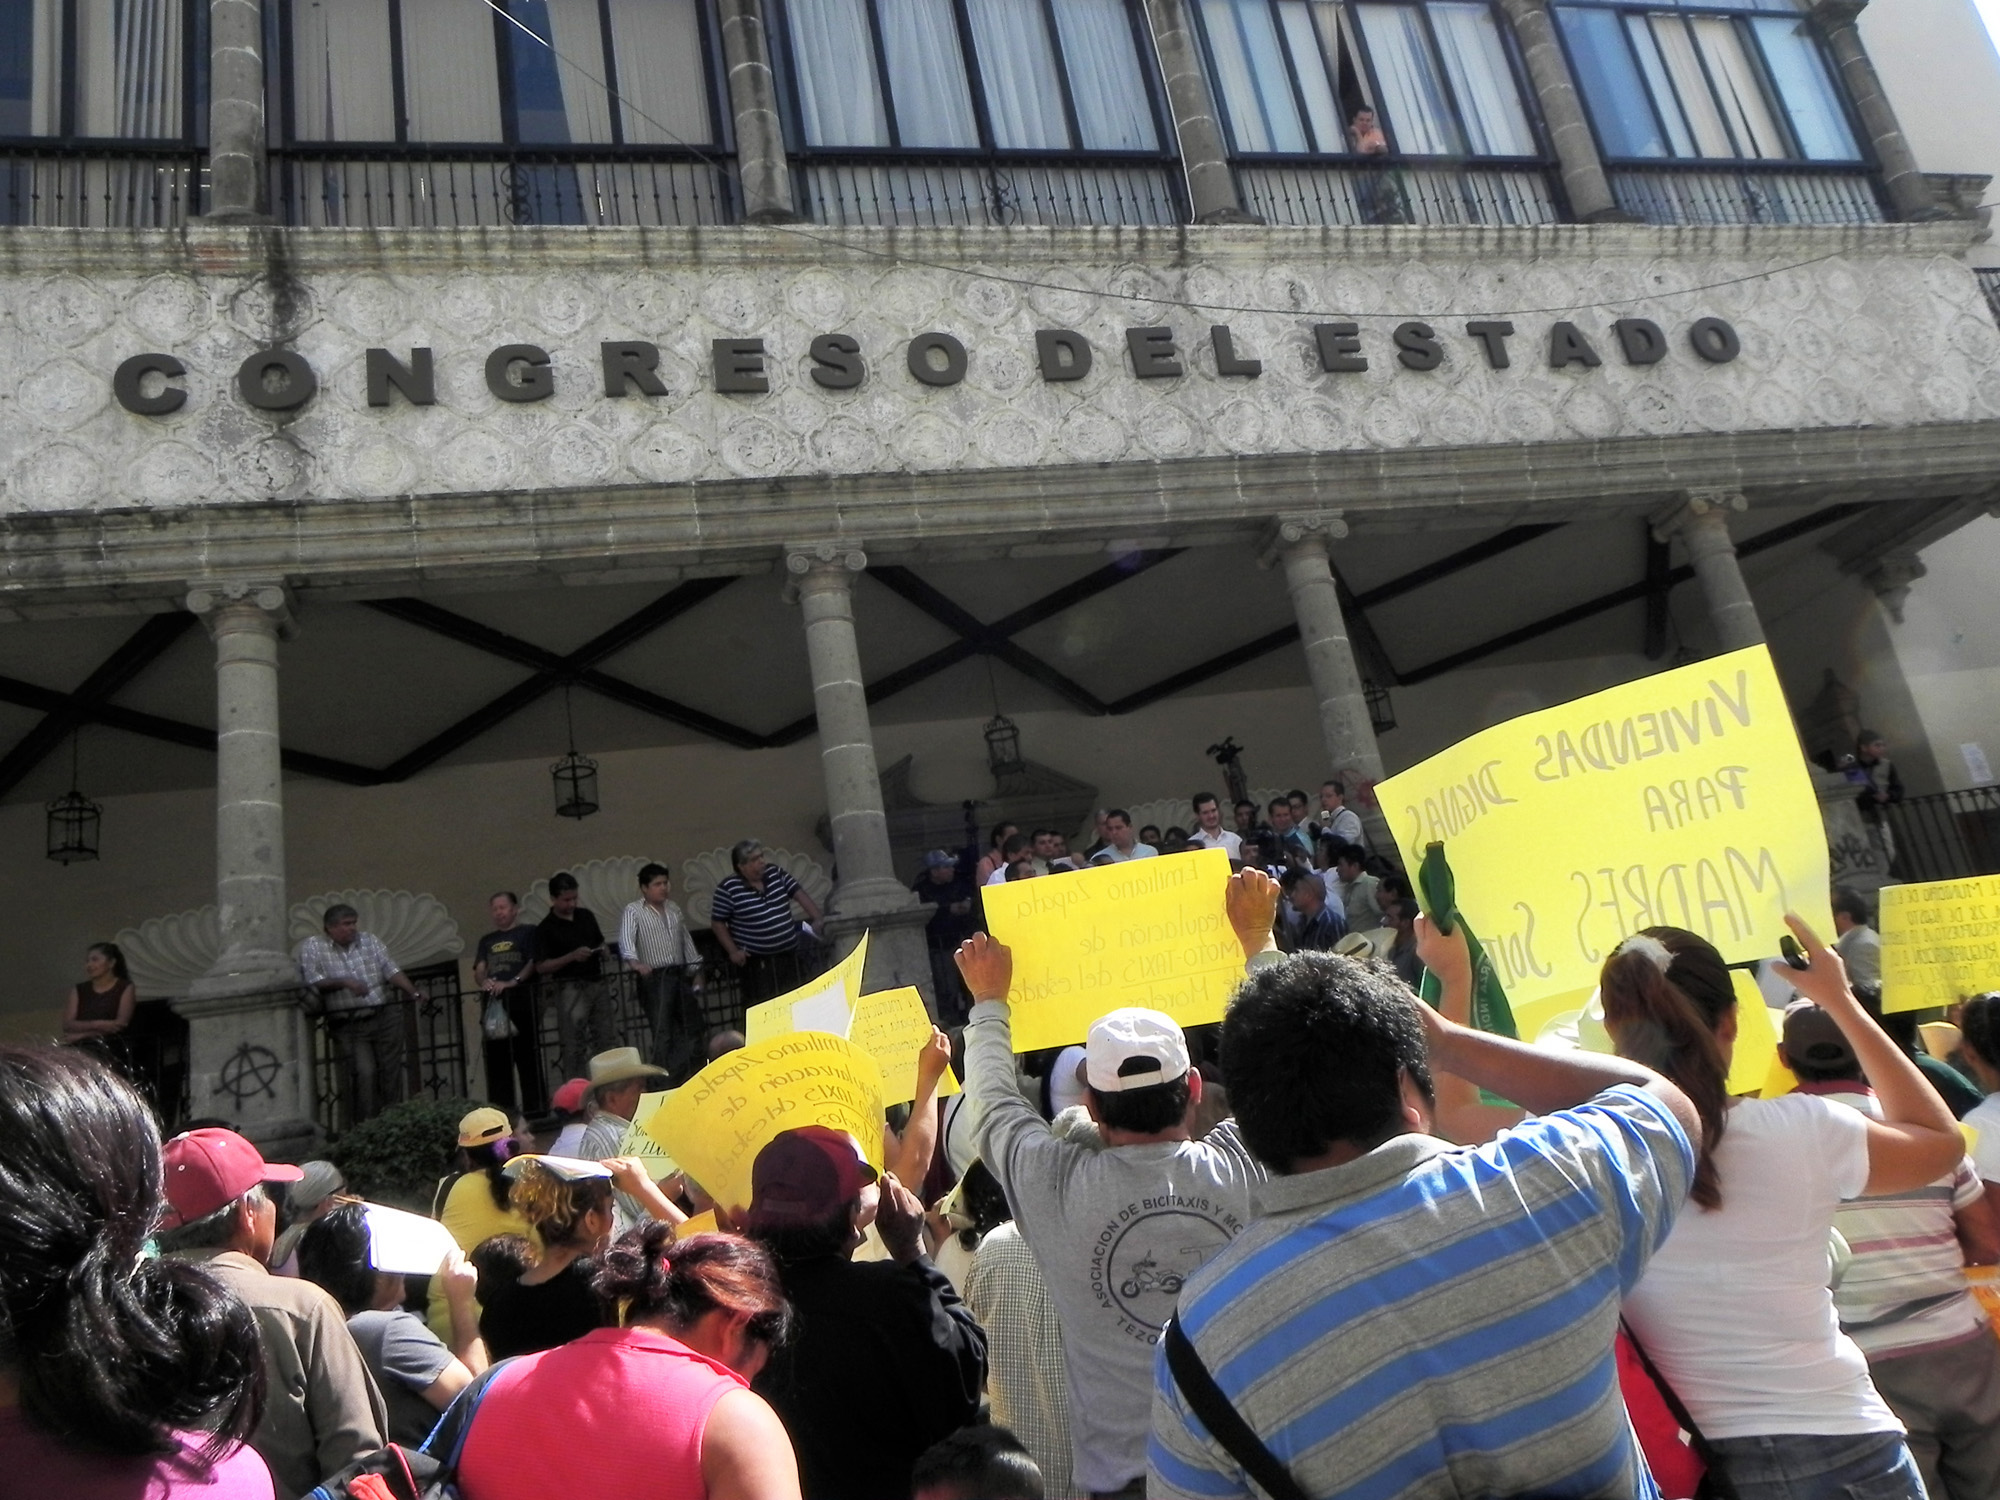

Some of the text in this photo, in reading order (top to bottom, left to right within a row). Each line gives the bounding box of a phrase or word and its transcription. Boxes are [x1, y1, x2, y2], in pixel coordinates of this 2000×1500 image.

[113, 316, 1742, 416] CONGRESO DEL ESTADO
[1090, 1220, 1121, 1309] ASOCIACION
[1118, 1203, 1140, 1223] DE
[1142, 1194, 1210, 1212] BICITAXIS
[1214, 1203, 1225, 1217] Y
